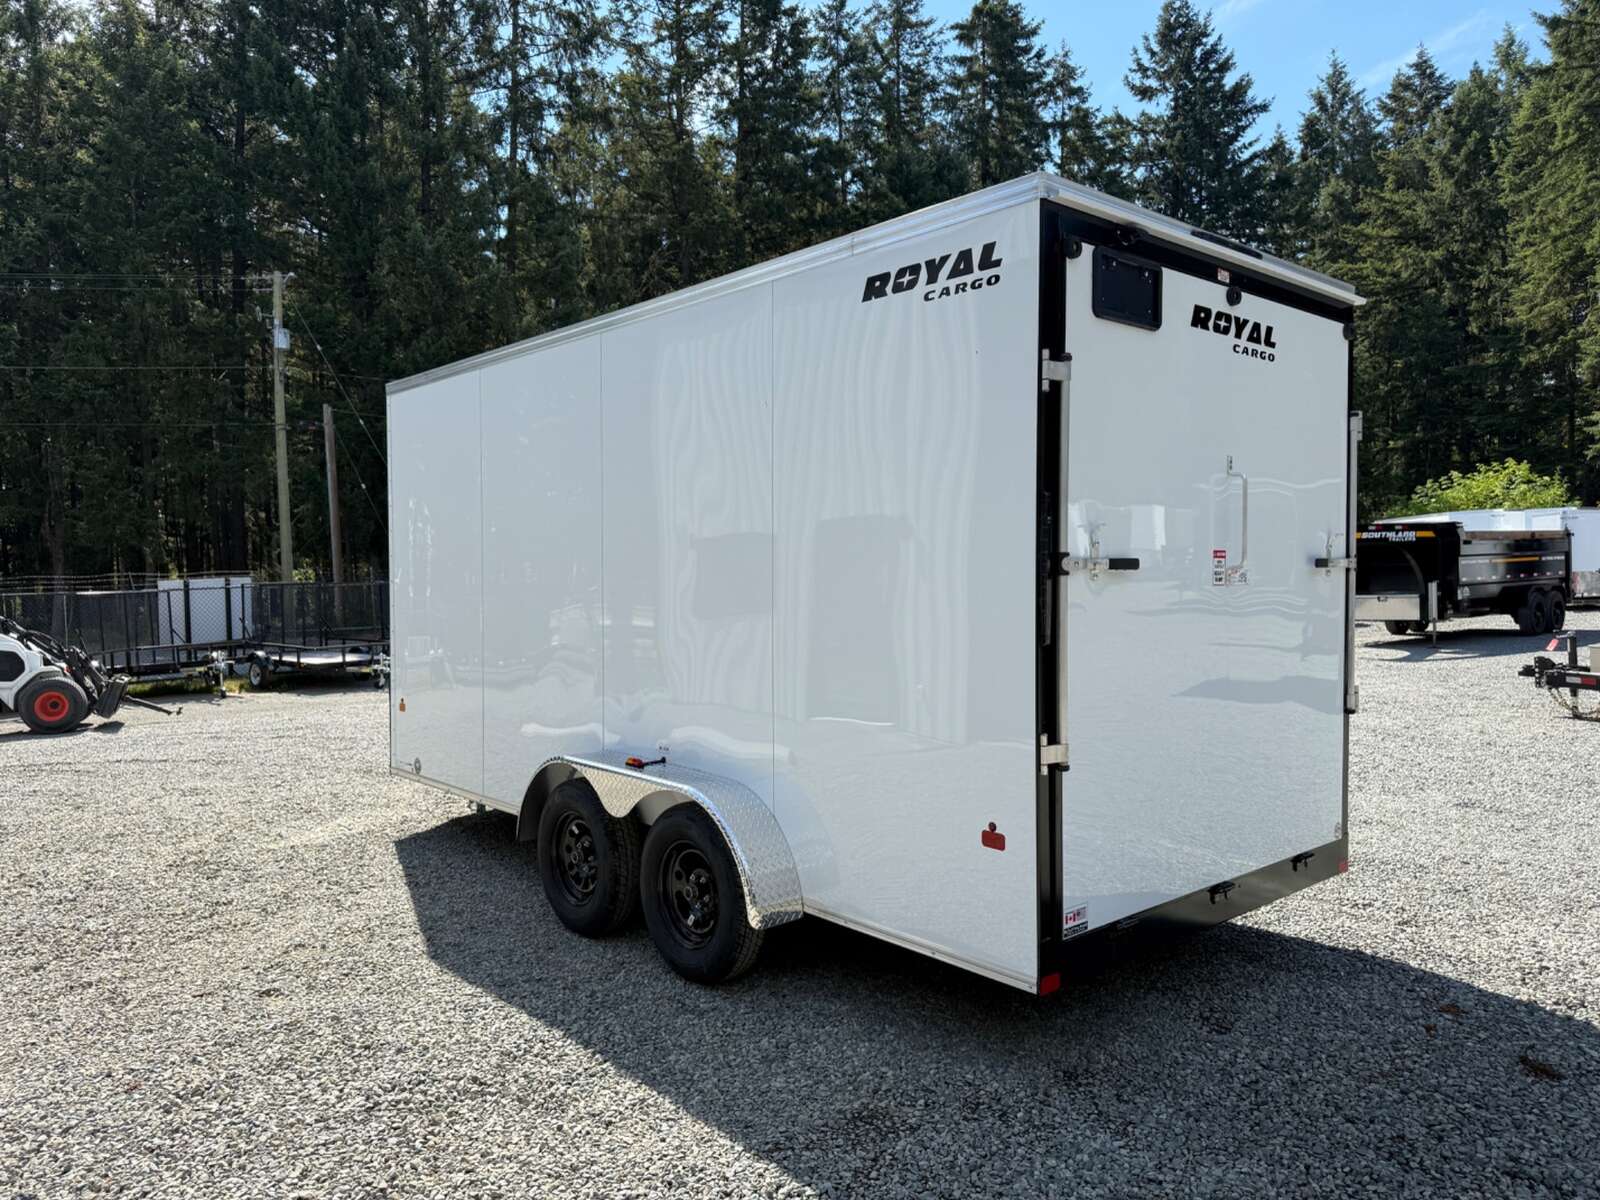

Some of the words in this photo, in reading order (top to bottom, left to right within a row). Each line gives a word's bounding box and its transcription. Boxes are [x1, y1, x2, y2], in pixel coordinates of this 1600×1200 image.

[861, 241, 1003, 303] ROYAL
[923, 274, 1001, 302] CARGO
[1190, 303, 1276, 349] ROYAL
[1232, 344, 1276, 362] CARGO
[1360, 530, 1416, 539] SOUTHLAND
